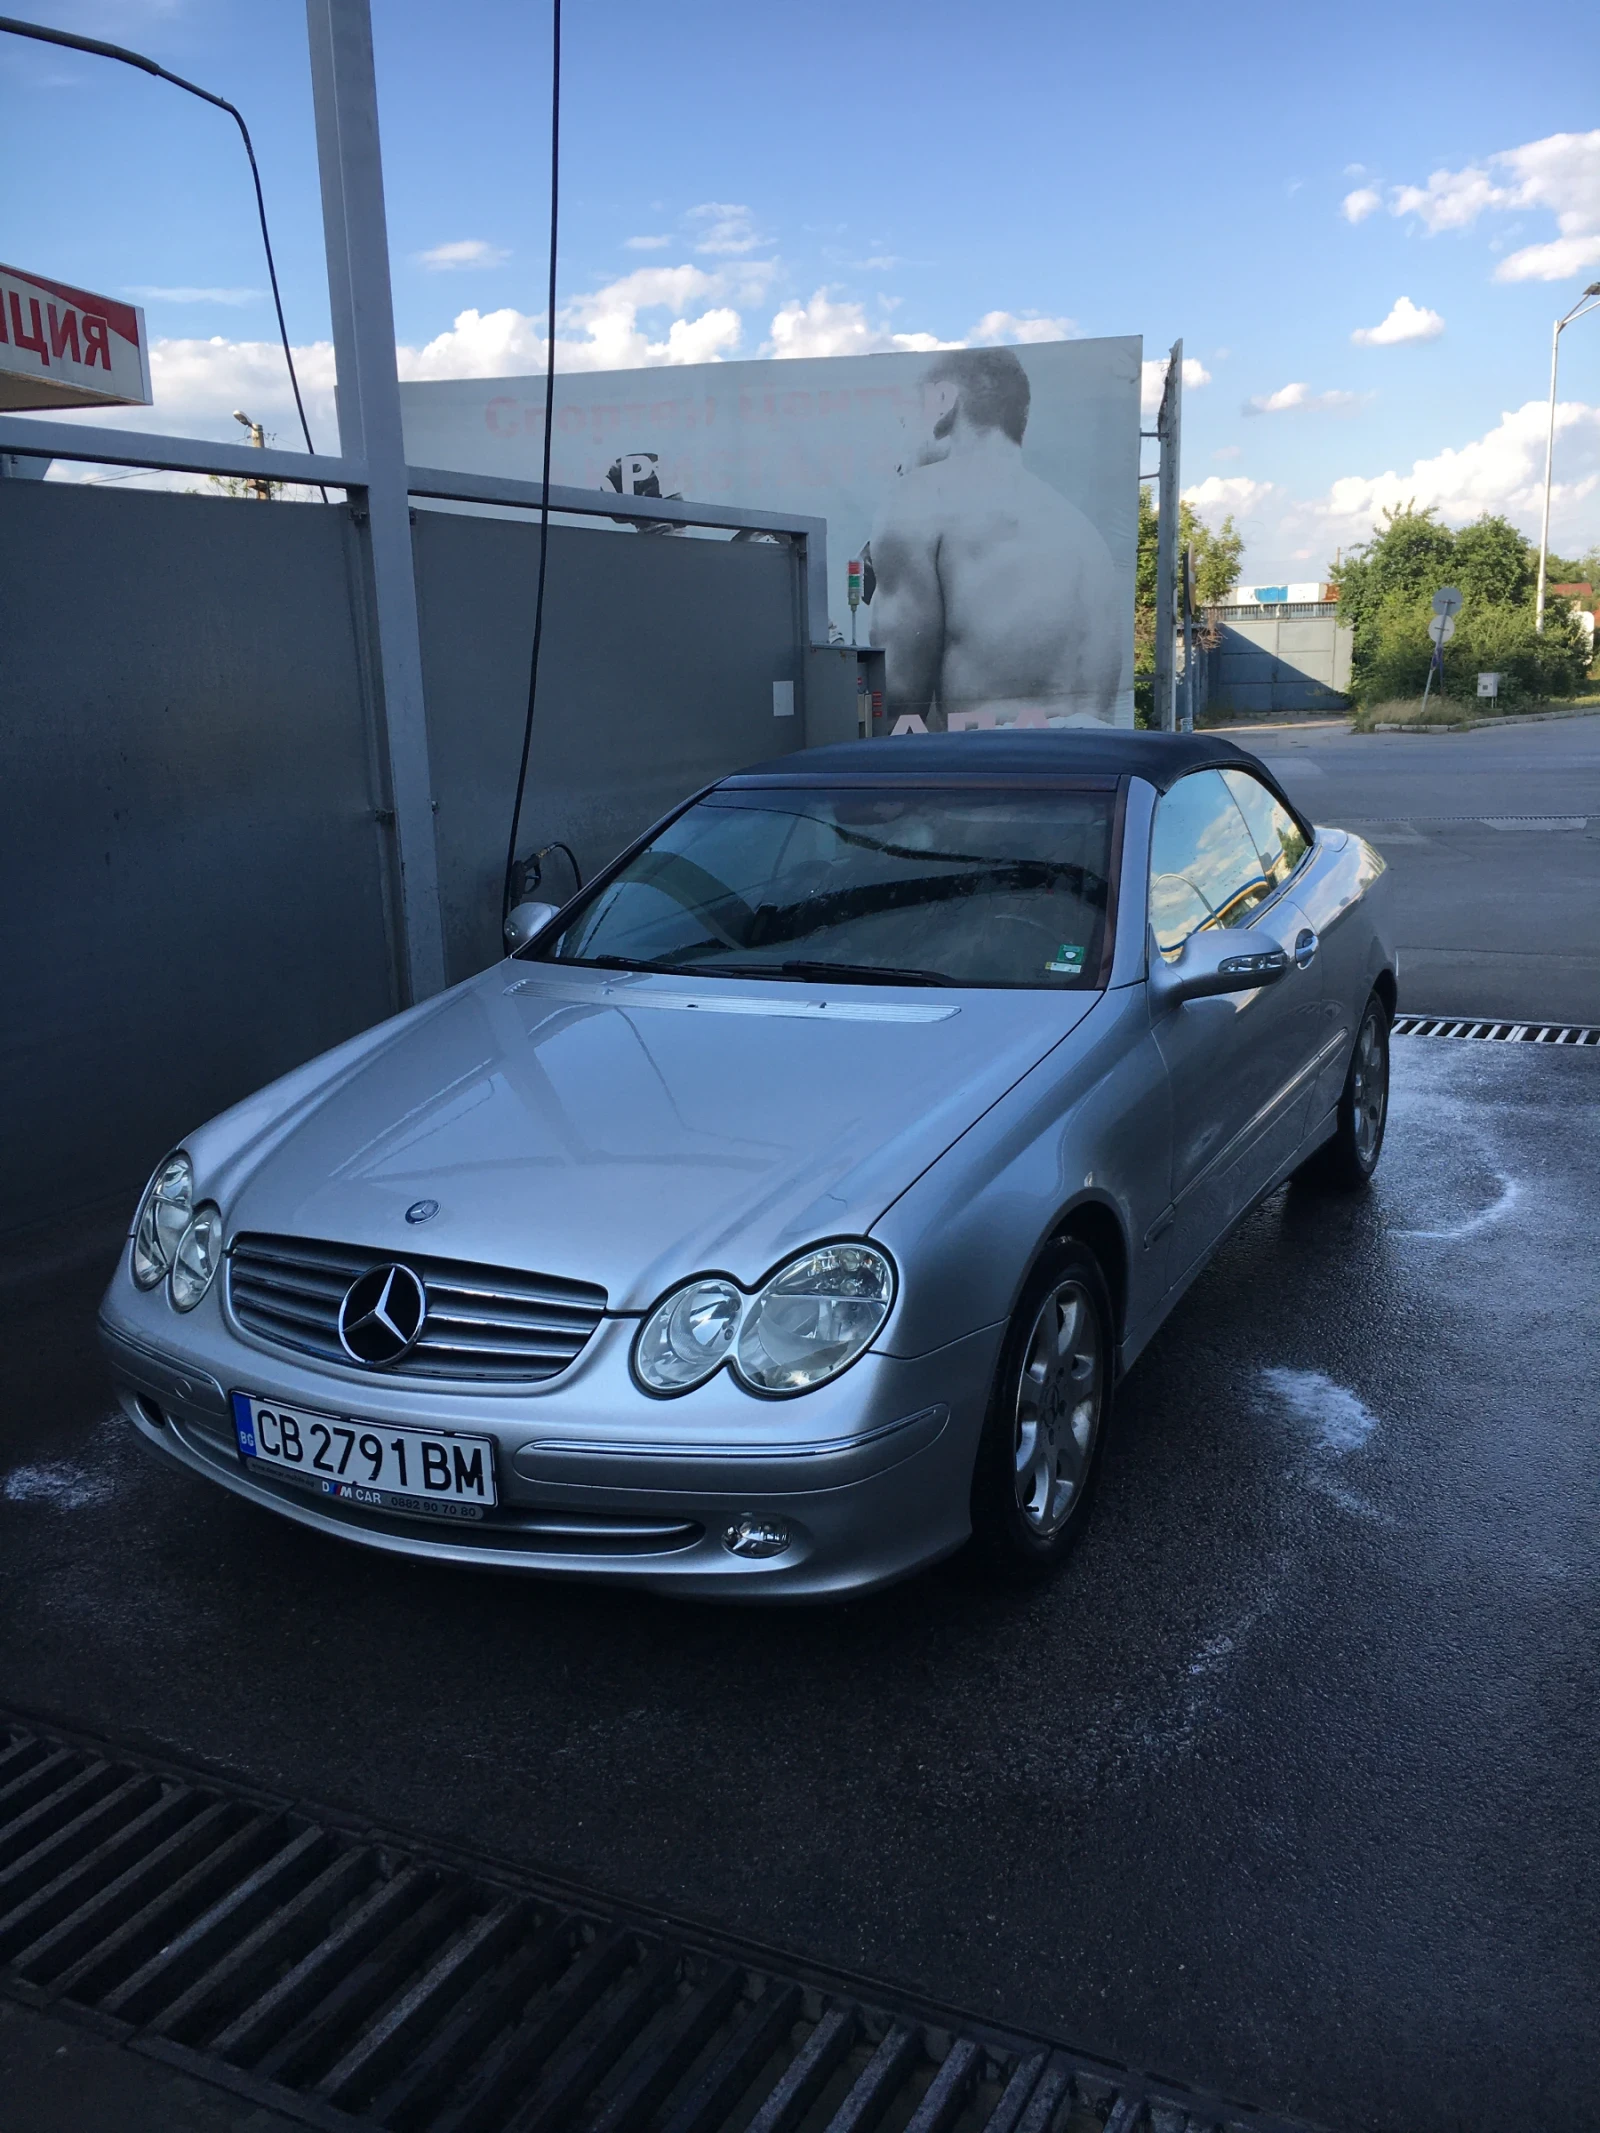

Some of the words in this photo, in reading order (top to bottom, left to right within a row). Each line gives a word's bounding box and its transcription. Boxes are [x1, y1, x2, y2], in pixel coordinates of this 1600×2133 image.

[0, 288, 112, 372] ЦИЯ
[240, 1431, 254, 1447] BG
[257, 1409, 304, 1463] CB
[309, 1423, 409, 1487] 2791
[421, 1441, 486, 1496] BM
[355, 1490, 382, 1505] CAR
[391, 1496, 421, 1510] 0882
[440, 1503, 457, 1516] 70
